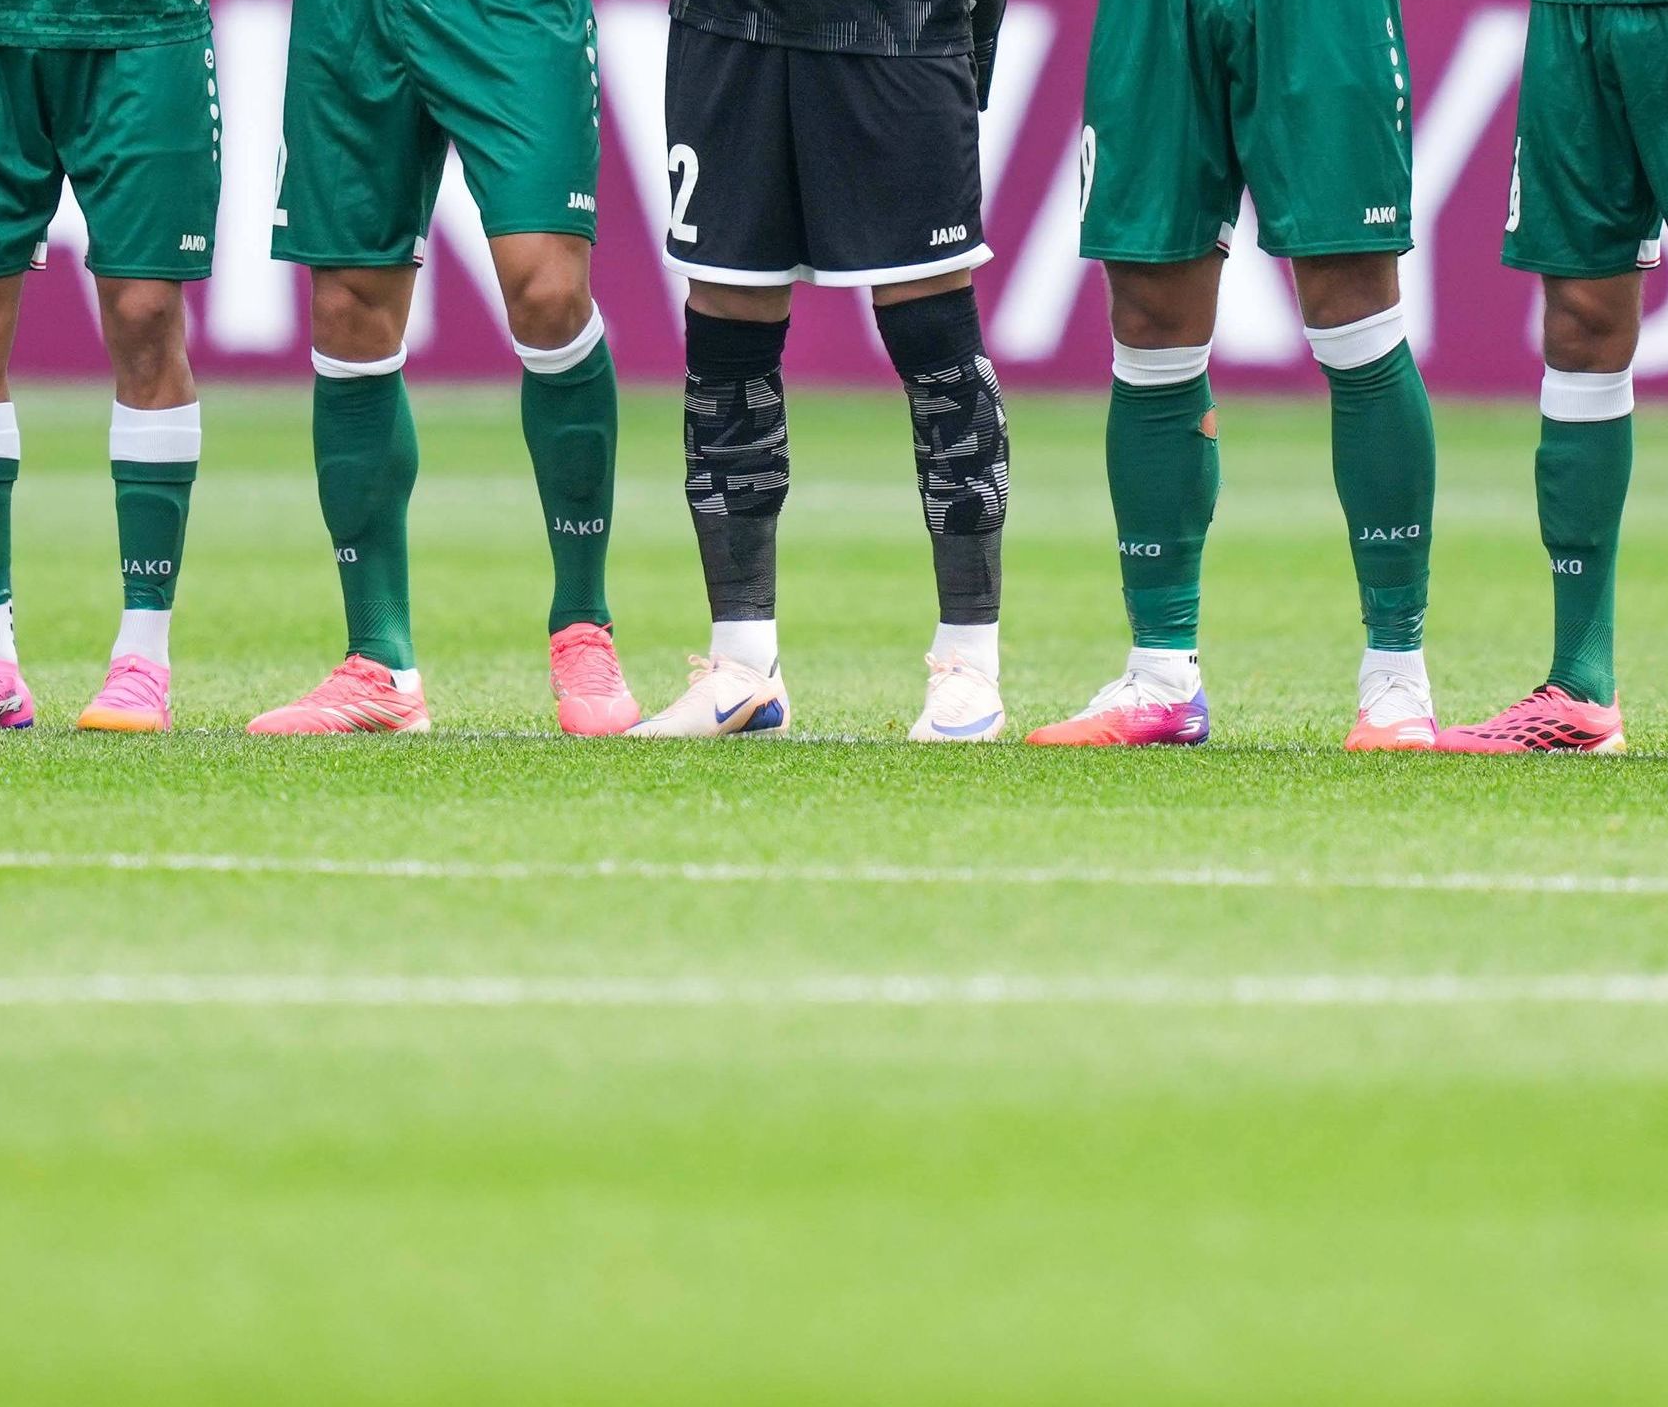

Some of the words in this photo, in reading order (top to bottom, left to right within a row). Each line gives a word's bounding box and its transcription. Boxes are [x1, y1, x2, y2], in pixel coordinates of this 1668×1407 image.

[567, 192, 596, 213] JAKO
[668, 143, 699, 244] 2
[1363, 206, 1397, 225] JAKO
[179, 234, 207, 252] JAKO
[929, 224, 967, 246] JAKO
[554, 517, 604, 535] JAKO
[1359, 524, 1420, 540] JAKO
[336, 547, 358, 563] KO
[1119, 541, 1162, 557] AKO
[122, 559, 172, 575] JAKO
[1550, 559, 1583, 575] AKO
